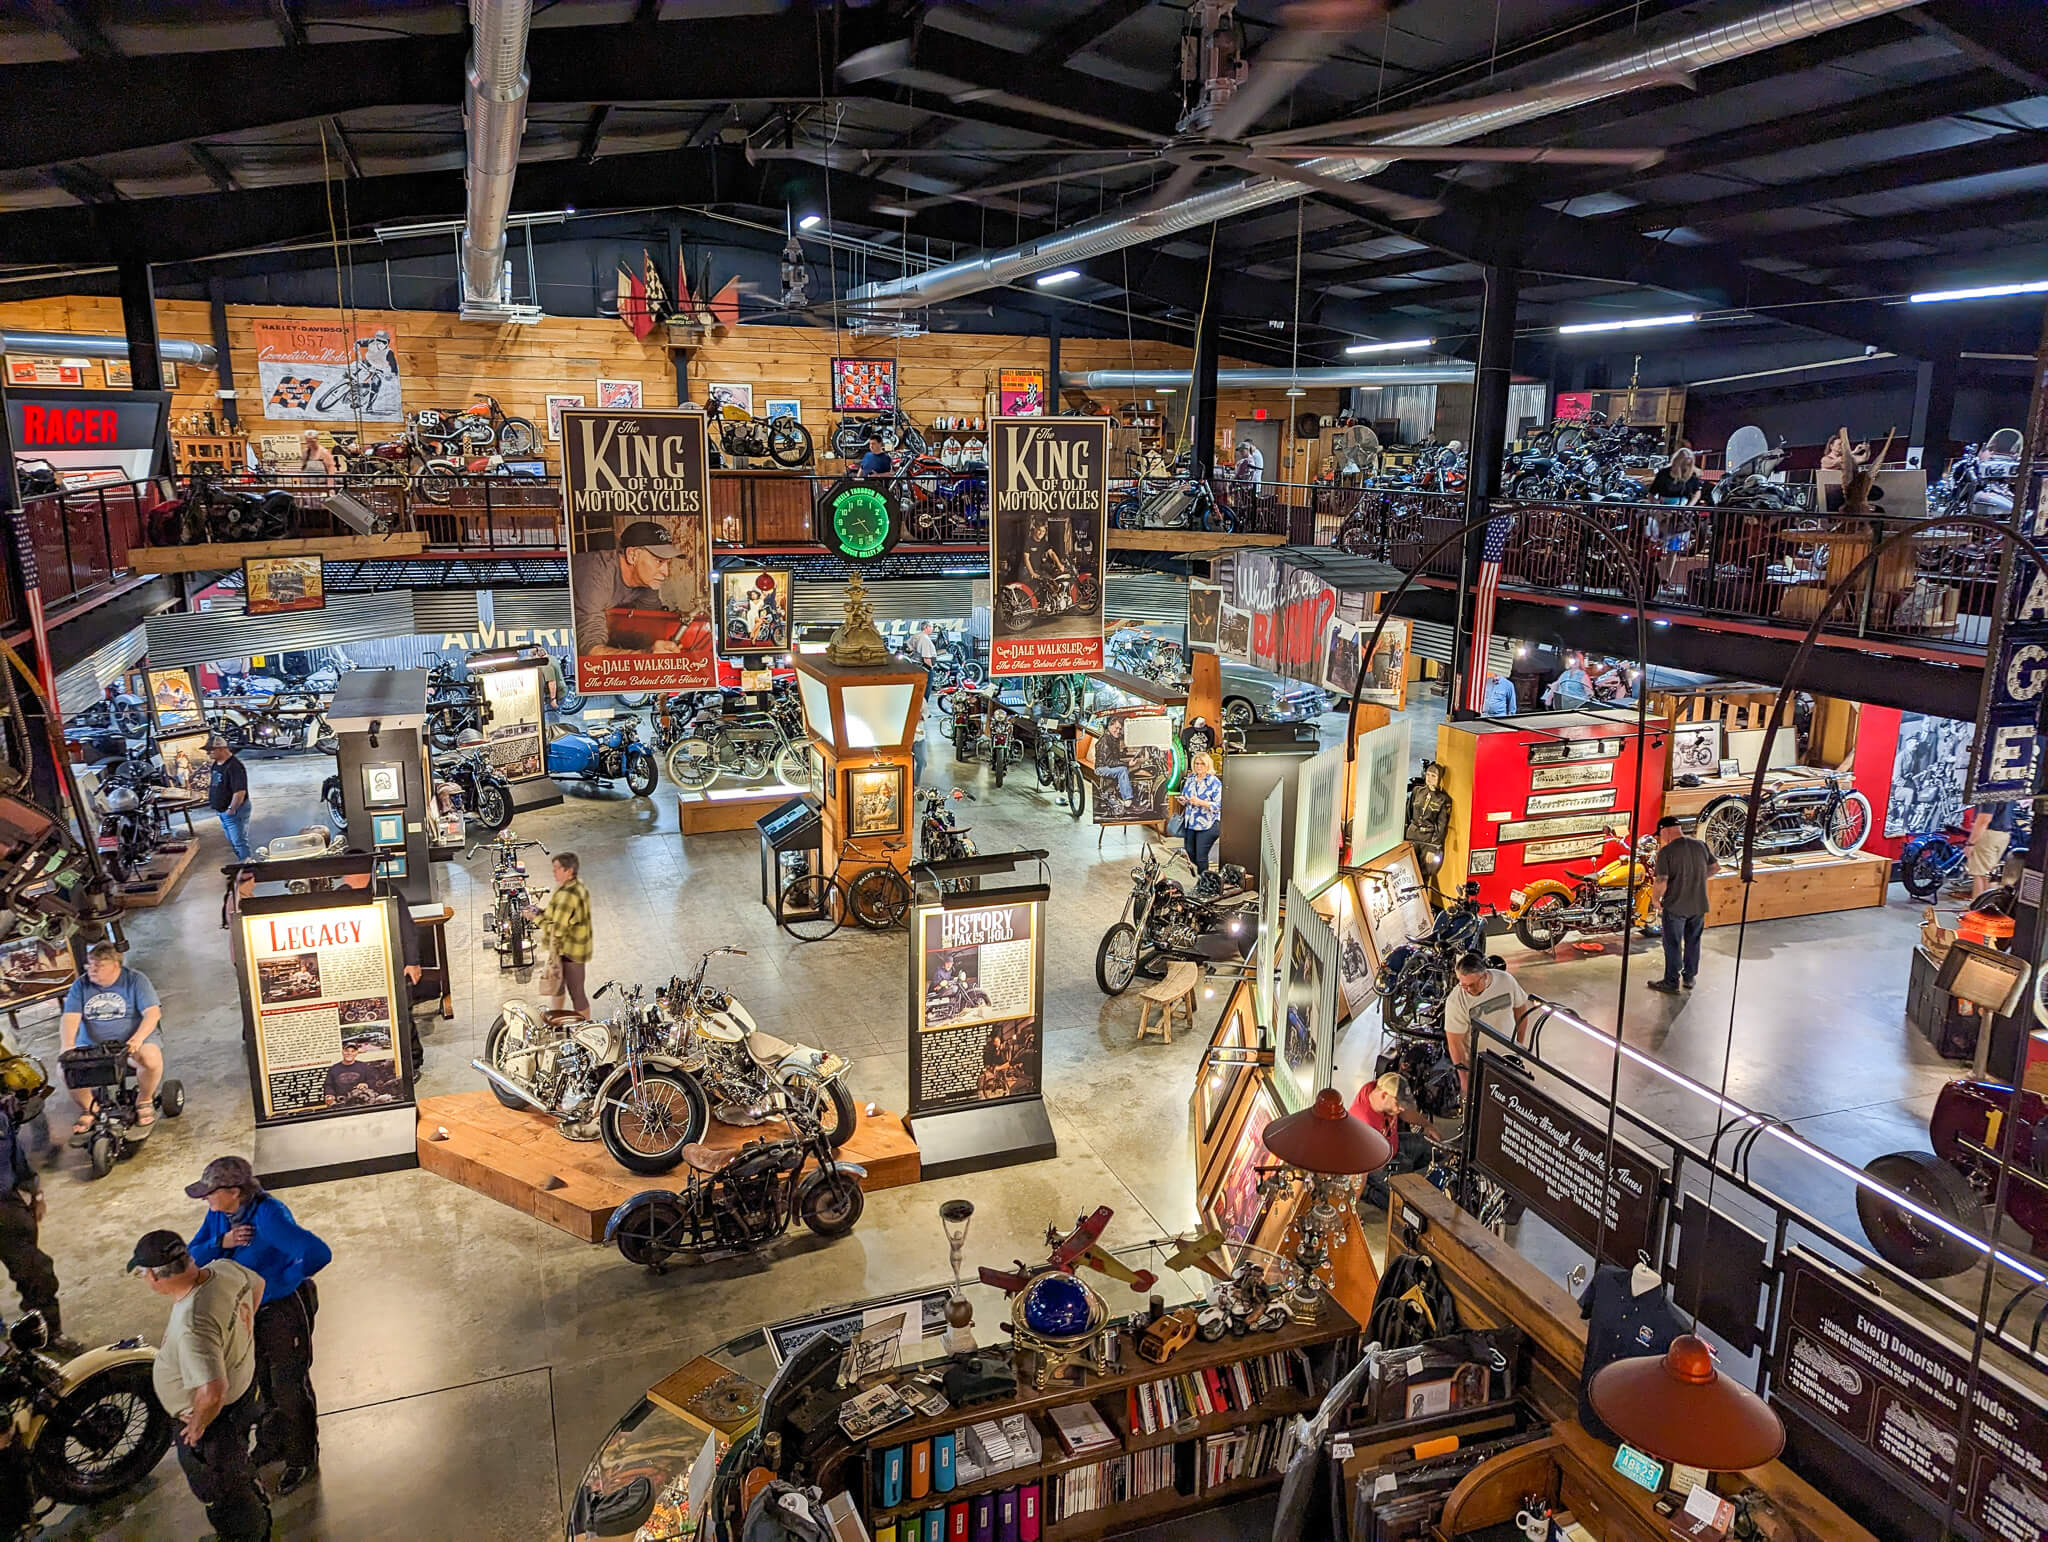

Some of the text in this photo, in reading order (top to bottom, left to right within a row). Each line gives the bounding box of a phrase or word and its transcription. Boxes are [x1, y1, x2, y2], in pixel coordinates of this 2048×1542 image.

[258, 345, 320, 362] Competition
[291, 334, 323, 348] 1957
[22, 405, 118, 444] RACER
[421, 412, 439, 425] 55
[618, 421, 640, 434] The
[775, 418, 793, 433] 94
[1036, 427, 1055, 439] The
[579, 420, 684, 490] KING
[1005, 427, 1089, 491] KING
[628, 477, 684, 490] OF OLD
[1042, 480, 1087, 491] OF OLD
[575, 491, 700, 514] MOTORCYCLES
[998, 490, 1099, 513] MOTORCYCLES
[1238, 566, 1320, 610] What's in the
[442, 620, 576, 650] AMERI
[995, 658, 1099, 671] The Man Behind The History
[1011, 642, 1083, 659] DALE WALKSLER
[601, 656, 690, 675] DALE WALKSLER
[585, 673, 709, 688] The Man Behind The History
[269, 920, 361, 952] LEGACY
[942, 909, 1014, 936] HISTORY
[952, 928, 1013, 947] TAKES HOLD
[1490, 1083, 1506, 1103] True
[1508, 1095, 1539, 1125] Passion
[1539, 1115, 1571, 1149] through
[1618, 1168, 1643, 1194] Times
[1985, 1109, 2003, 1149] 1
[1503, 1113, 1513, 1126] Your
[1513, 1120, 1534, 1141] Generous
[1534, 1134, 1552, 1154] Support
[1552, 1147, 1566, 1162] helps
[1566, 1157, 1585, 1175] sustain
[1585, 1169, 1594, 1181] the
[1505, 1126, 1520, 1141] growth
[1526, 1140, 1534, 1152] the
[1534, 1145, 1555, 1166] Museum
[1555, 1160, 1565, 1172] and
[1565, 1166, 1573, 1178] the
[1573, 1173, 1594, 1194] ongoing
[1501, 1133, 1519, 1151] educate
[1519, 1145, 1527, 1155] our
[1527, 1151, 1545, 1169] Visitors
[1545, 1163, 1552, 1173] on
[1552, 1167, 1560, 1180] the
[1560, 1173, 1578, 1194] history
[1585, 1189, 1594, 1204] The
[1527, 1161, 1536, 1174] You
[1536, 1170, 1545, 1180] are
[1545, 1175, 1557, 1189] what
[1605, 1215, 1617, 1232] That
[1823, 1326, 1840, 1342] David
[1850, 1342, 1872, 1364] Limited
[1872, 1357, 1893, 1377] Edition
[1894, 1371, 1910, 1388] Print
[1824, 1318, 1849, 1339] Lifetime
[1848, 1334, 1879, 1359] Admission
[1880, 1354, 1890, 1365] for
[1890, 1360, 1902, 1374] You
[1902, 1369, 1915, 1383] and
[1915, 1376, 1934, 1395] Three
[1793, 1368, 1825, 1397] Recognition
[1857, 1314, 2019, 1431] Every Donorship Inludes:
